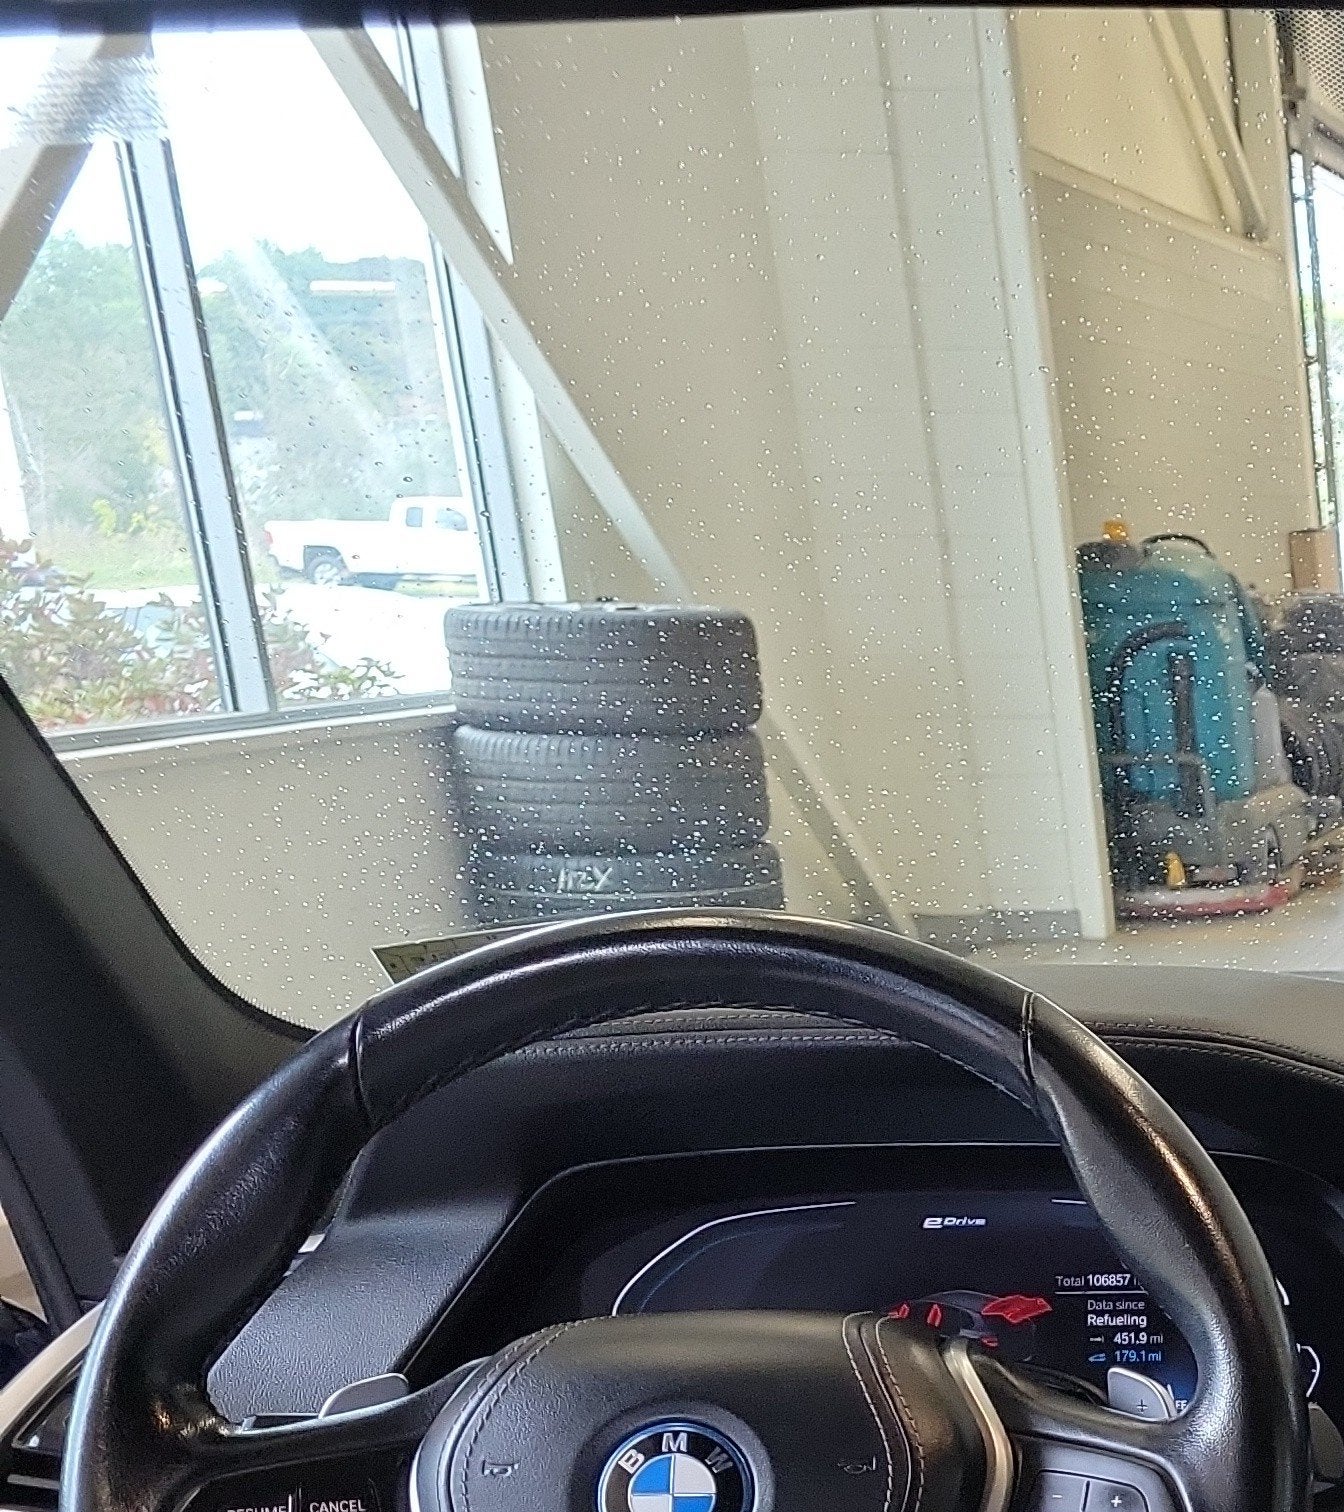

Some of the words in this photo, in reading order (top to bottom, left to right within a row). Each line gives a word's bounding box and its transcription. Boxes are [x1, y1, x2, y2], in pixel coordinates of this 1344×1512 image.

[1055, 1275, 1085, 1287] Total
[1086, 1273, 1131, 1287] 106857
[1087, 1299, 1113, 1310] Data
[1115, 1299, 1146, 1310] since
[1087, 1313, 1147, 1328] Refueling
[1113, 1331, 1148, 1345] 451.9
[1149, 1334, 1164, 1344] mi
[1114, 1349, 1146, 1362] 179.1
[1148, 1350, 1162, 1362] mi
[618, 1432, 733, 1474] BMW
